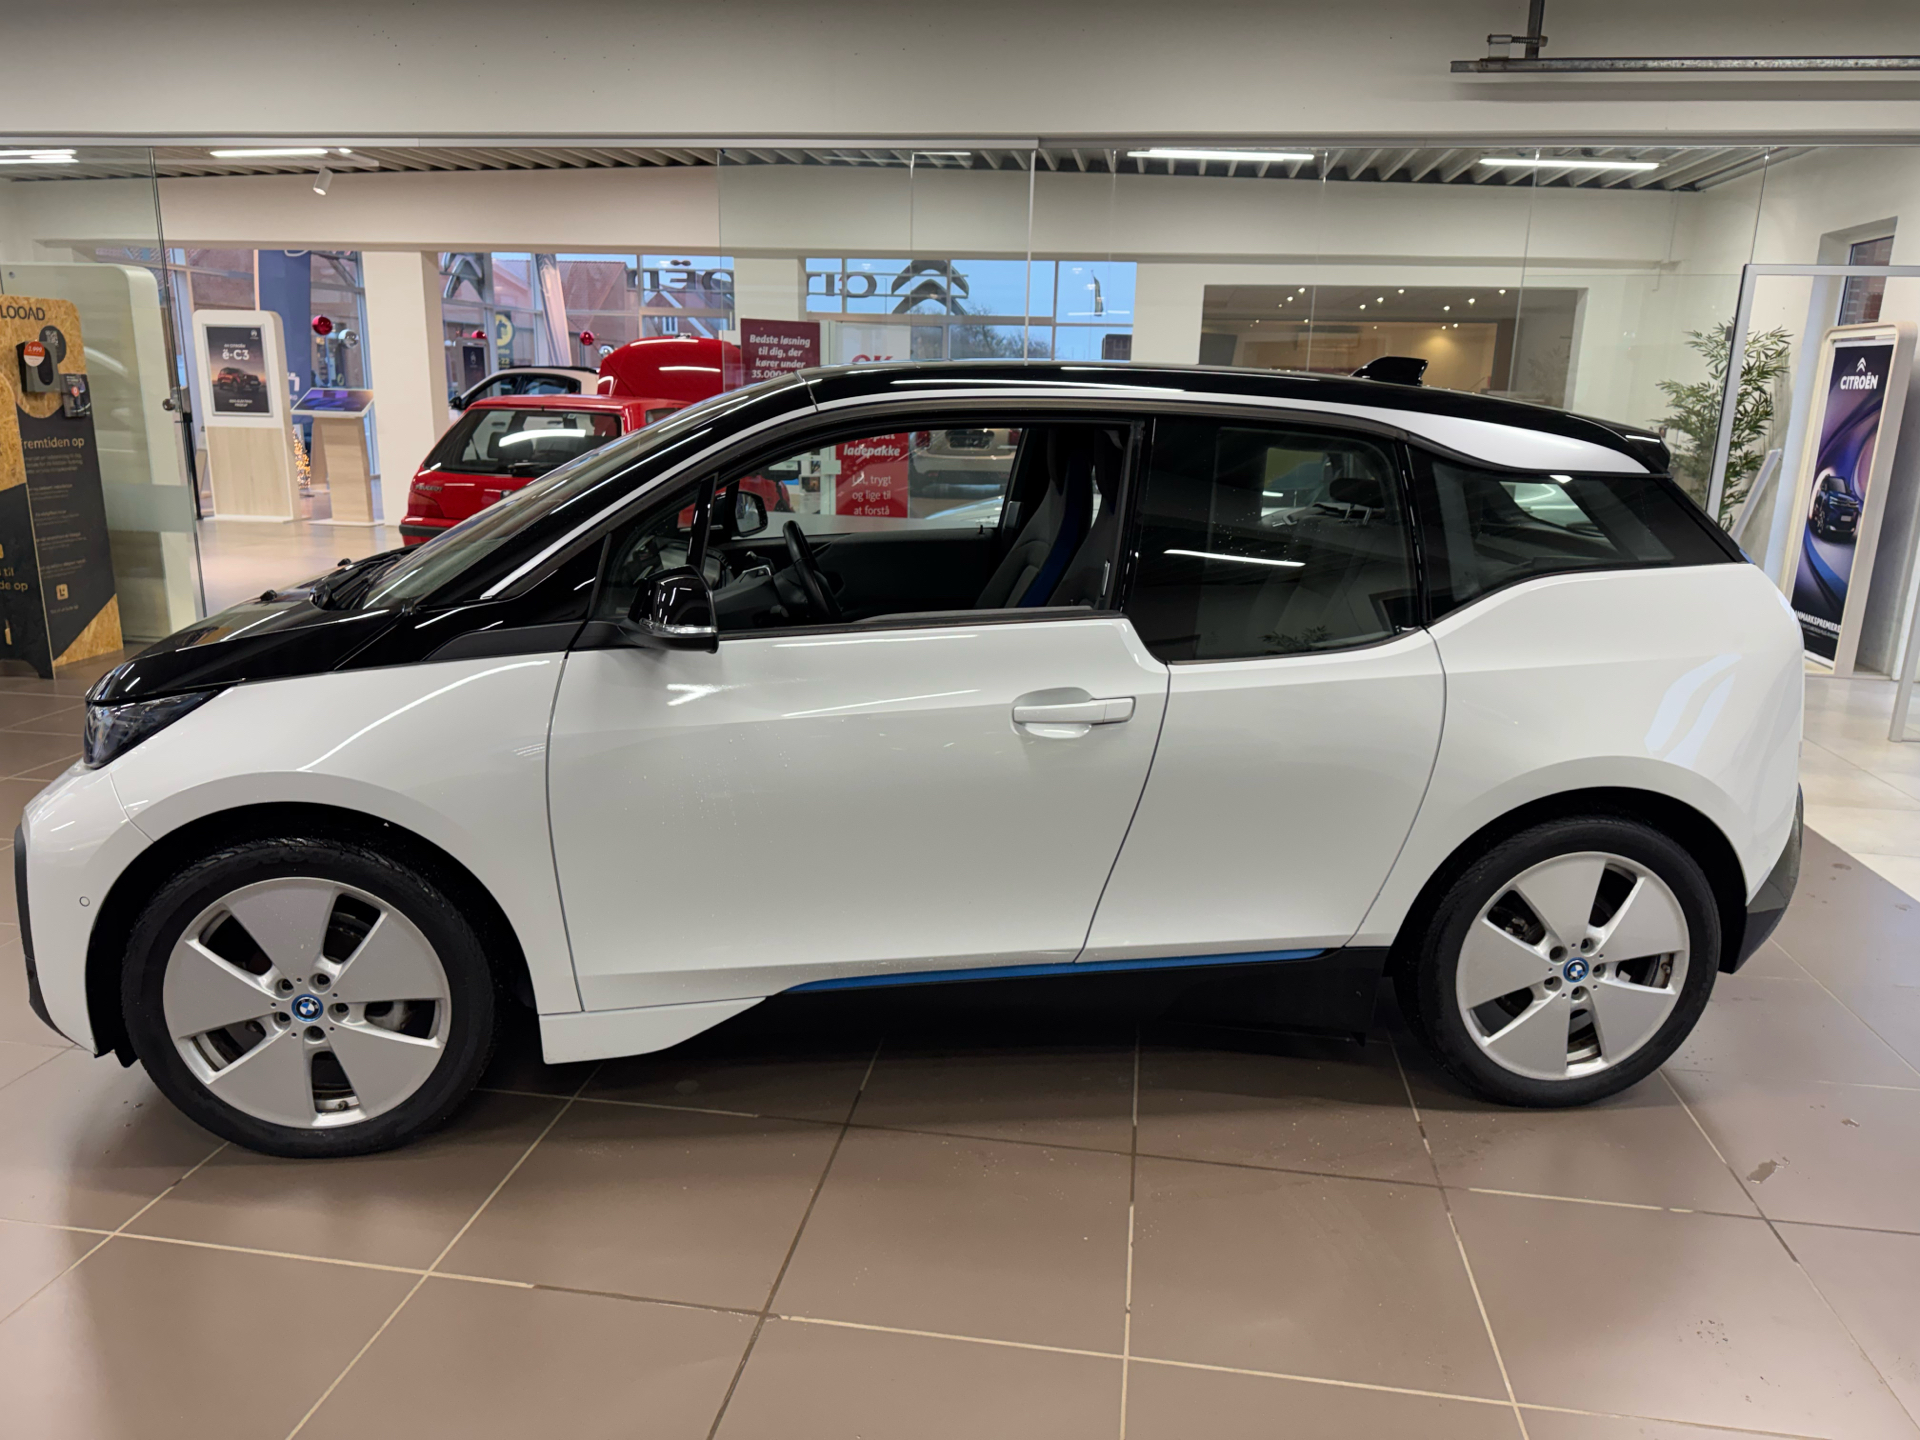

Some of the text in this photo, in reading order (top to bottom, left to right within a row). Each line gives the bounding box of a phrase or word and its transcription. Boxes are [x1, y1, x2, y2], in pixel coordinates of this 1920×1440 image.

[749, 334, 811, 348] Bedste løsning
[758, 347, 803, 358] til dig, der
[755, 358, 806, 369] kører under
[1840, 371, 1879, 390] CITROËN
[72, 438, 85, 448] op
[843, 444, 900, 459] ladepakke
[870, 476, 892, 487] trygt
[852, 490, 891, 502] og lige til
[854, 505, 890, 516] at forstå
[3, 567, 14, 577] til
[13, 582, 28, 593] op
